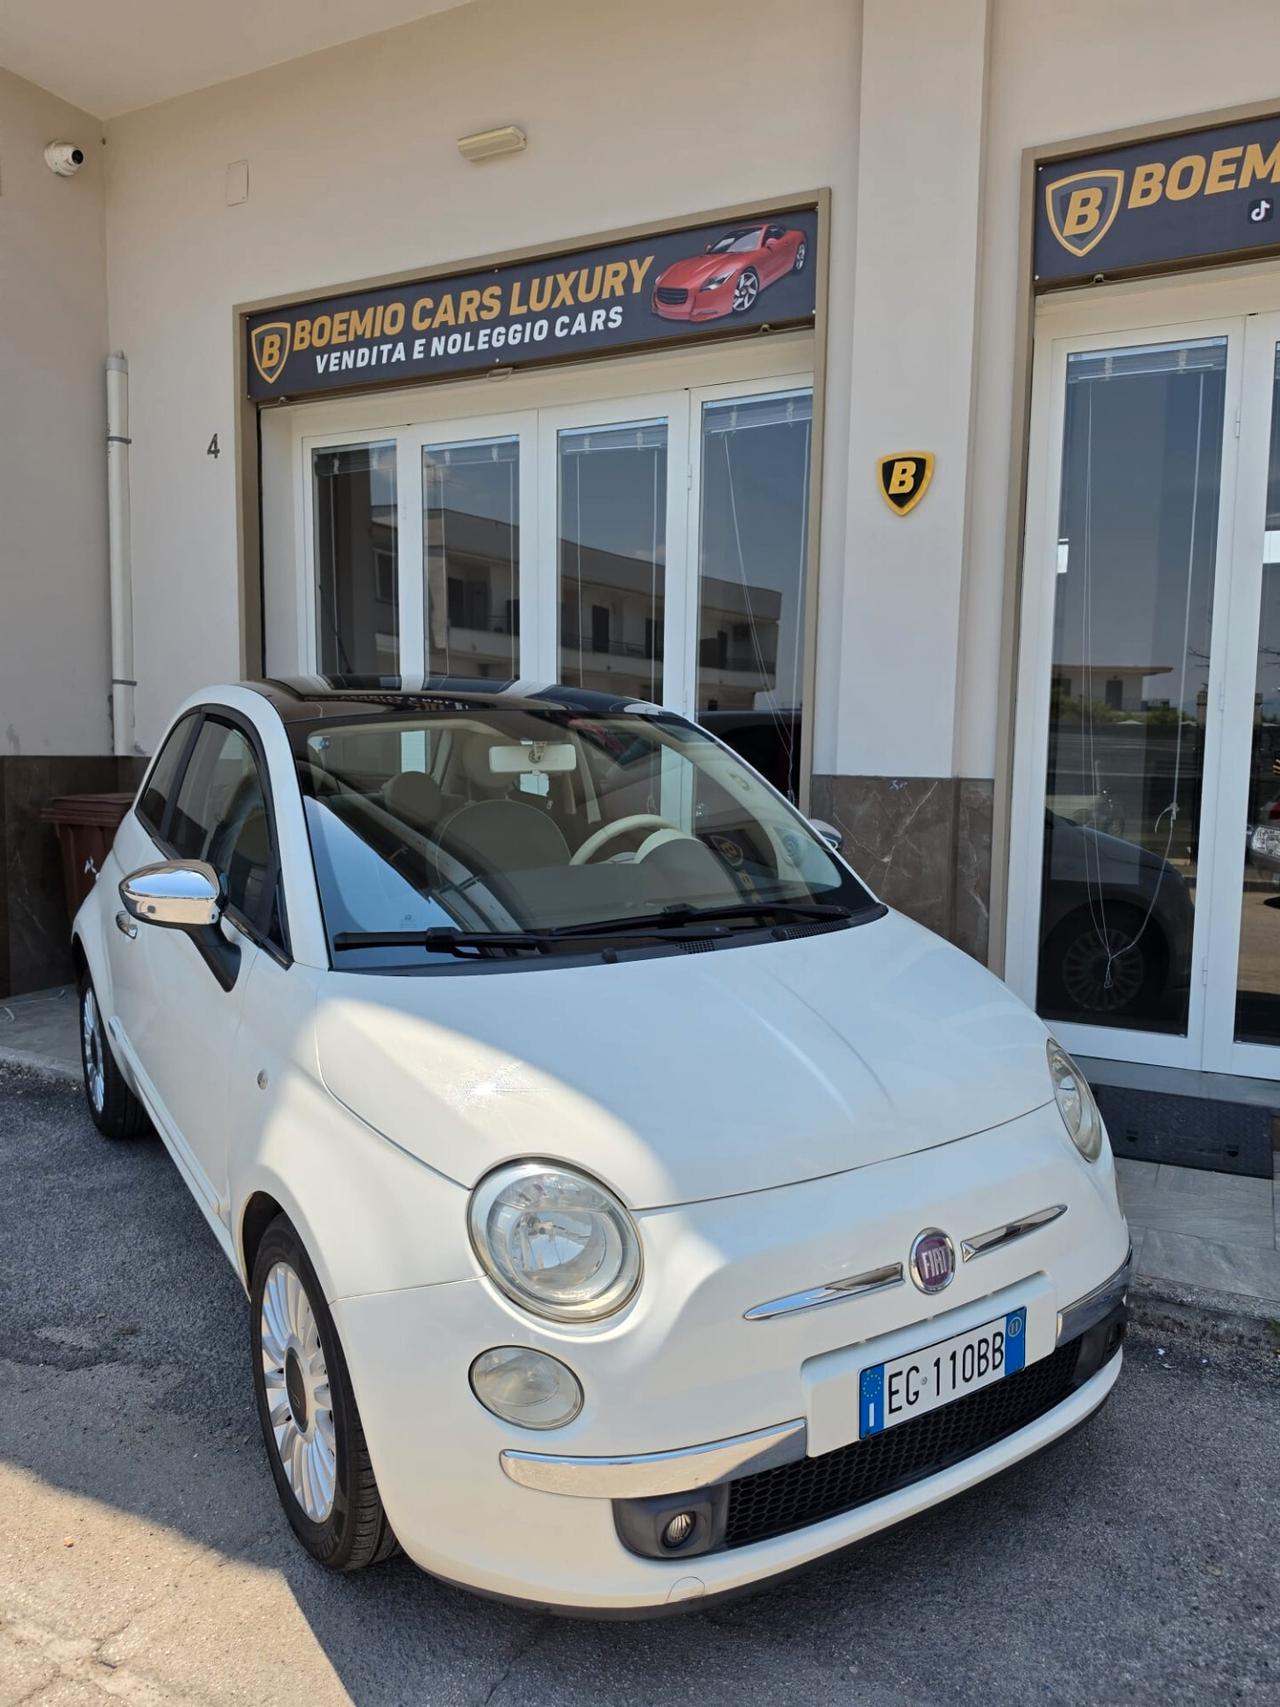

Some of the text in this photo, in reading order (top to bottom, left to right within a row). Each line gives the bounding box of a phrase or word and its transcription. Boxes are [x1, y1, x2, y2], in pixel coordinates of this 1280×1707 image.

[1062, 187, 1103, 237] B
[293, 256, 655, 352] BOEMIO CARS LUXURY
[261, 334, 281, 369] B
[315, 306, 624, 374] VENDITA E NOLEGGIO CARS
[207, 433, 220, 459] 4
[888, 460, 917, 495] B
[921, 1247, 948, 1279] FIAT
[888, 1331, 1004, 1415] EG 110BB
